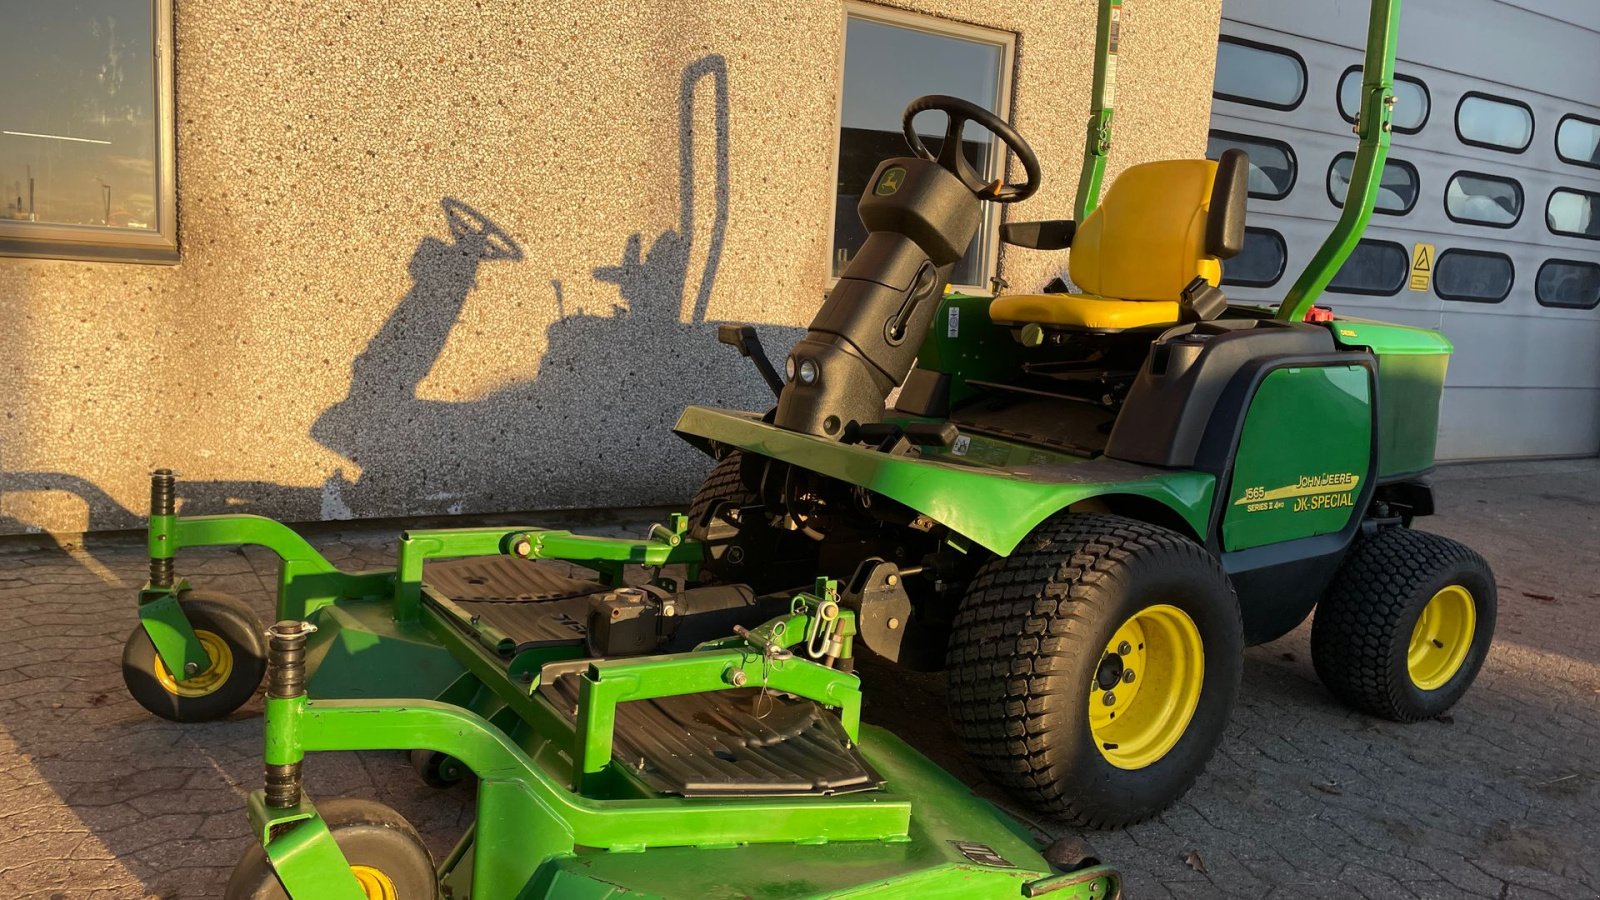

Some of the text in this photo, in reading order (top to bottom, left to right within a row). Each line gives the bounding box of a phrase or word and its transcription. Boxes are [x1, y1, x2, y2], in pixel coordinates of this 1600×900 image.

[1296, 474, 1321, 488] JOHN
[1245, 486, 1265, 500] 1565
[1247, 502, 1269, 512] SERIES
